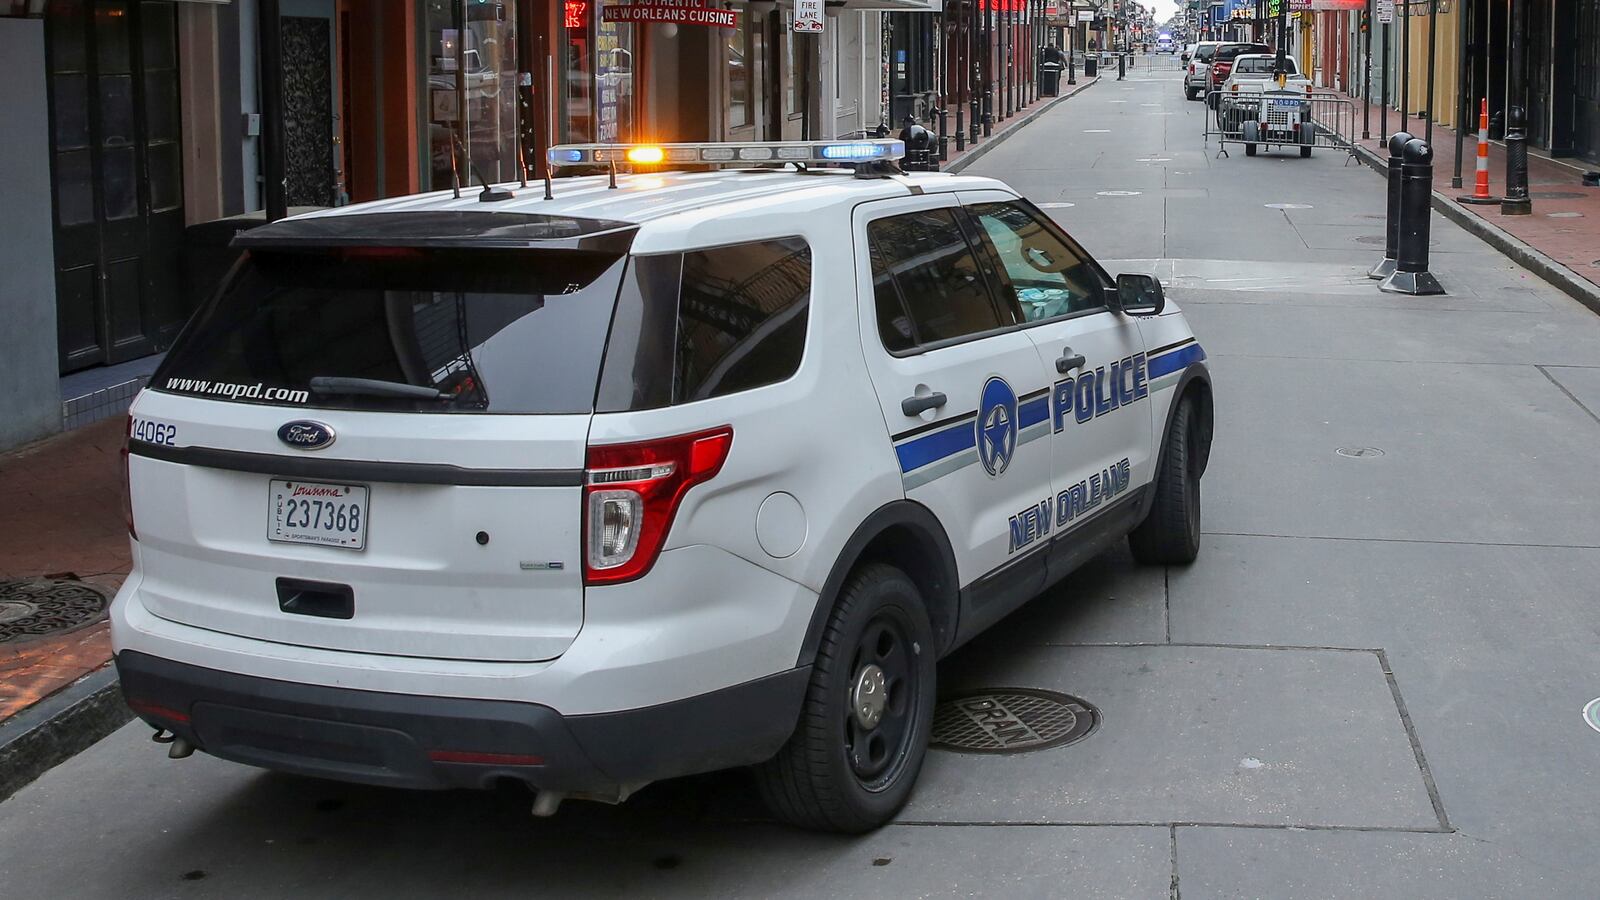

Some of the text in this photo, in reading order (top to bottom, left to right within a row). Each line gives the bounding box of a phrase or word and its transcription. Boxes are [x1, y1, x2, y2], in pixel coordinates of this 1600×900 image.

[800, 11, 818, 20] LANE
[801, 1, 817, 10] FIRE
[605, 8, 735, 26] NEW ORLEANS CUISINE
[166, 377, 309, 403] www.nopd.com
[1052, 352, 1150, 435] POLICE
[132, 418, 177, 446] 14062
[286, 426, 320, 444] Ford
[292, 484, 343, 497] Louisiana
[286, 498, 361, 533] 237368
[1008, 457, 1131, 555] NEW ORLEANS
